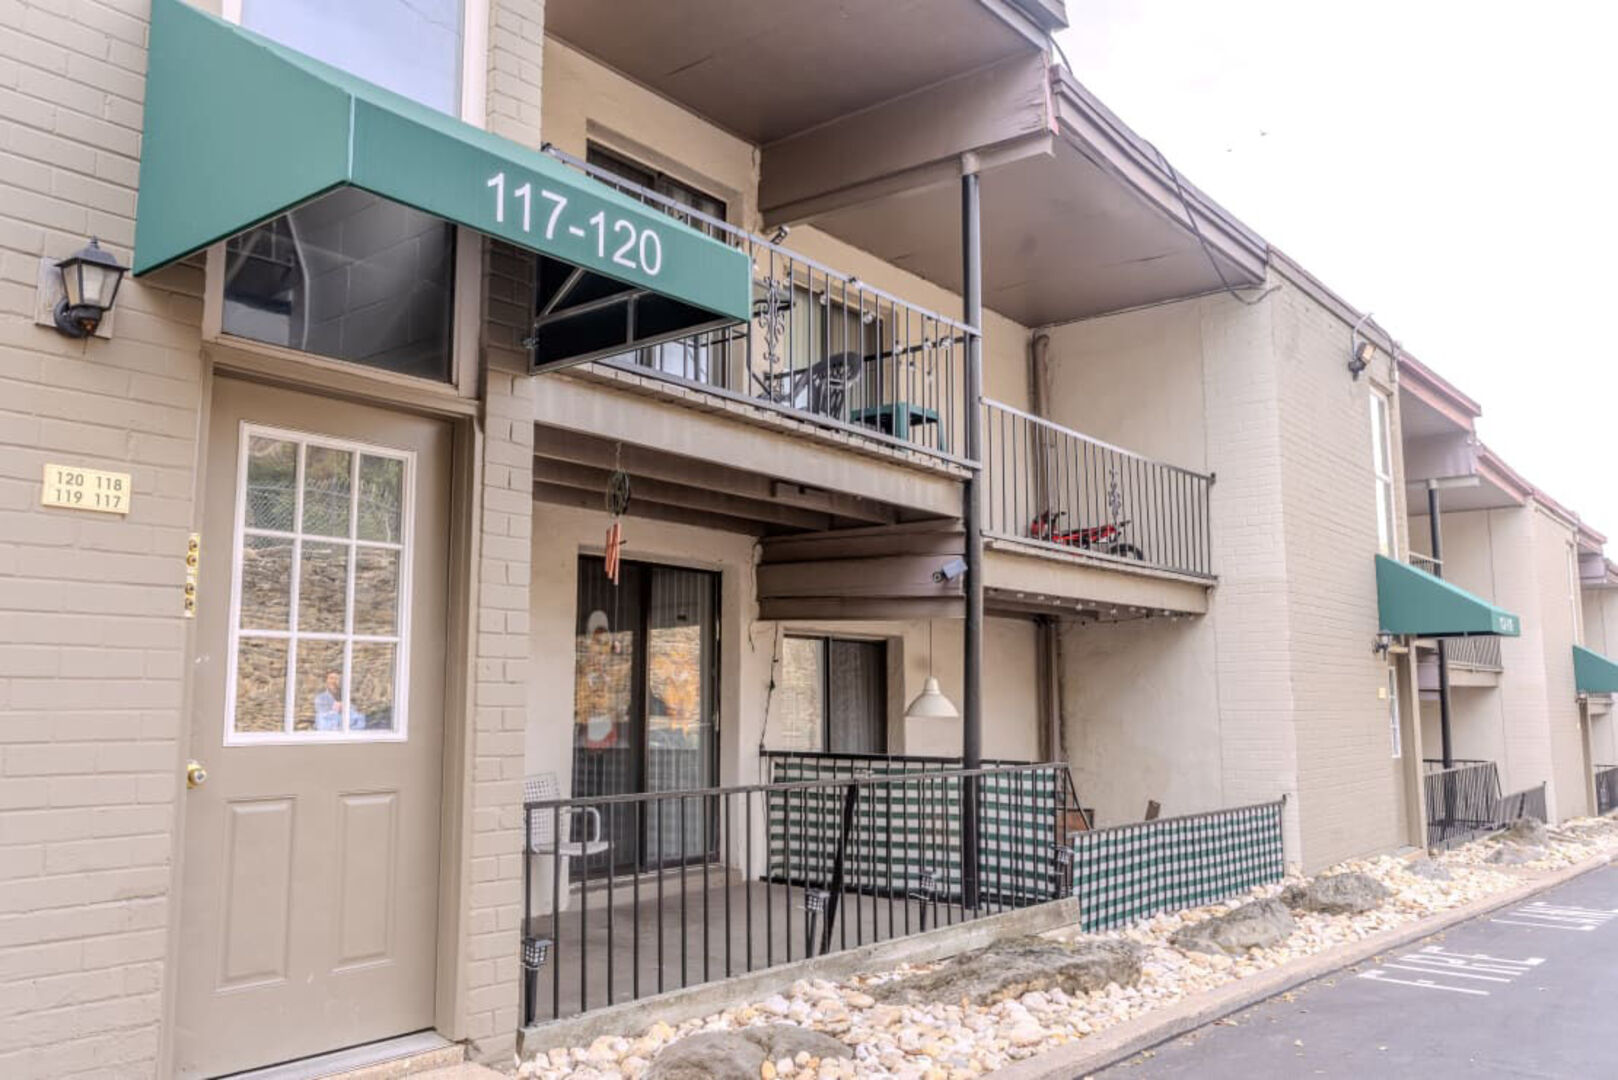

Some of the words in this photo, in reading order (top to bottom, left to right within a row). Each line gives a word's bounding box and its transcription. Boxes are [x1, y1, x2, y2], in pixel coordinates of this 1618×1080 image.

[487, 171, 662, 276] 117-120
[56, 489, 83, 504] 119
[95, 493, 121, 508] 117
[57, 471, 85, 487] 120
[96, 476, 122, 491] 118
[1357, 945, 1546, 996] FIRE
